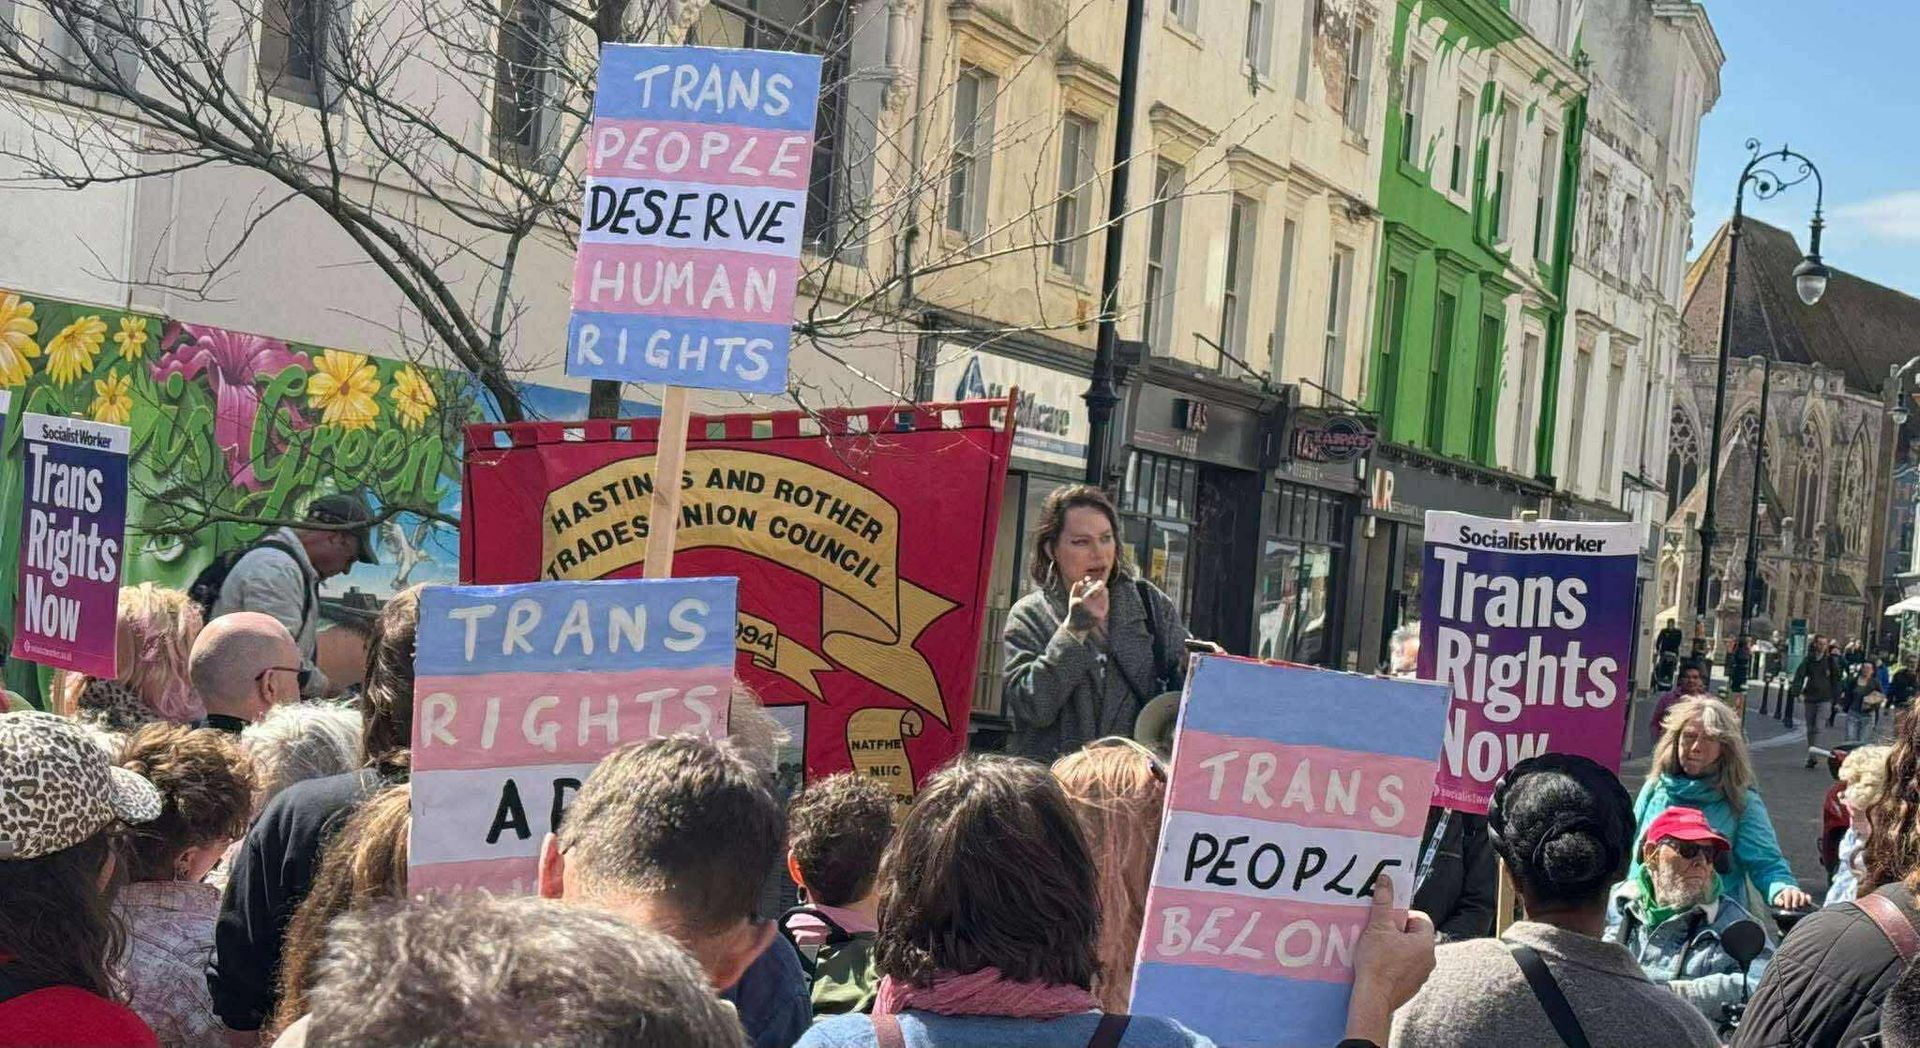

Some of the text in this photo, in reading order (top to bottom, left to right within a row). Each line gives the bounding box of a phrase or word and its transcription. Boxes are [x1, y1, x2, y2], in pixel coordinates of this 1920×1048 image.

[634, 62, 793, 117] TRANS
[595, 127, 807, 178] PEOPLE
[587, 185, 796, 243] DESERVE
[590, 259, 777, 313] HUMAN
[577, 323, 773, 382] RIGHTS
[29, 442, 104, 514] Trans
[234, 364, 448, 541] Green
[551, 467, 884, 545] HASTINS AND ROTHER
[27, 508, 118, 588] Rights
[547, 515, 649, 582] TRADES
[768, 515, 884, 589] COUNCIL
[24, 573, 81, 643] Now
[1434, 546, 1588, 630] Trans
[448, 598, 710, 662] TRANS
[1436, 626, 1618, 722] Rights
[421, 684, 718, 750] RIGHTS
[851, 738, 902, 750] NATFHE
[1439, 708, 1549, 782] Now
[1199, 750, 1406, 828] TRANS
